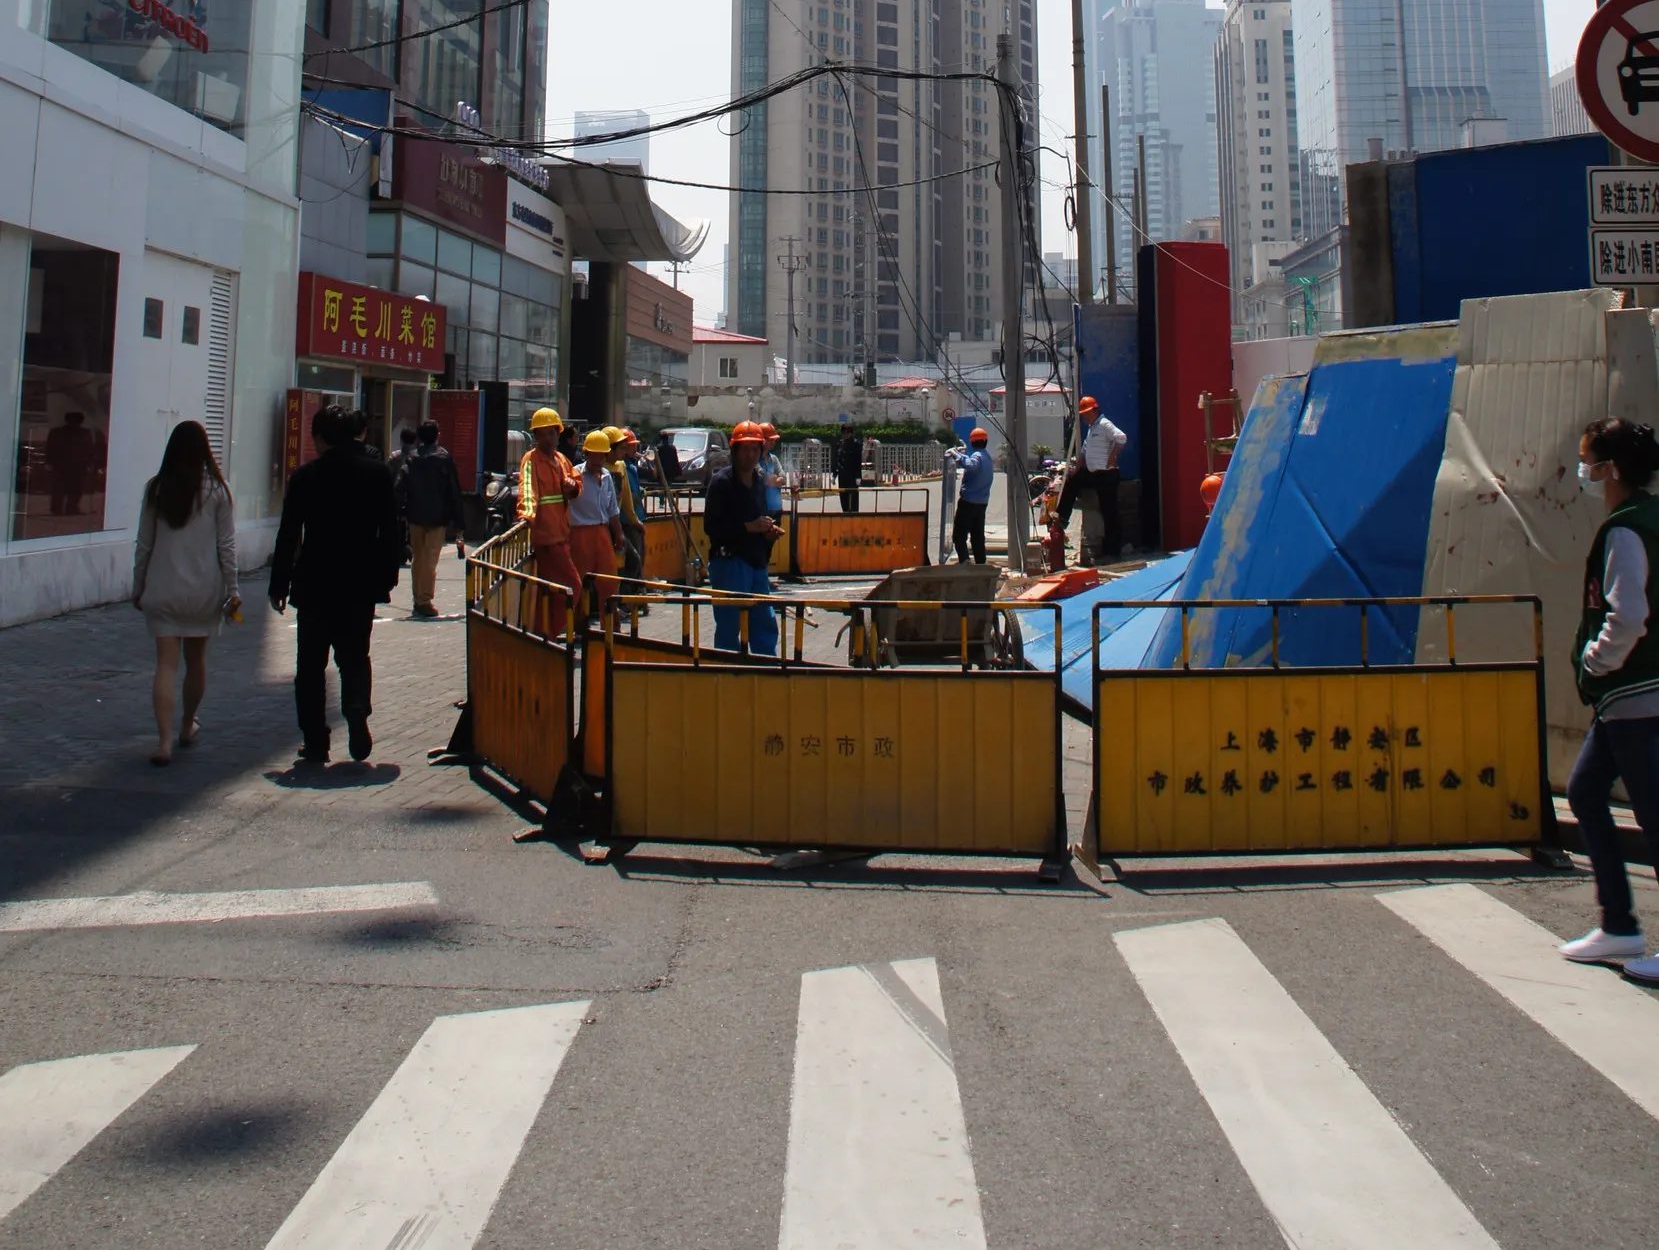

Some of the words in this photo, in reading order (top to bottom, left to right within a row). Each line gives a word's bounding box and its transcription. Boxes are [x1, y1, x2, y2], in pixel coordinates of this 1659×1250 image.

[323, 288, 437, 349] 阿毛川菜馆
[287, 399, 299, 482] 阿毛川菜
[763, 733, 894, 758] 静安市政
[1220, 726, 1422, 753] 上海市静安区
[1147, 766, 1495, 796] 市政养护工程有限公司
